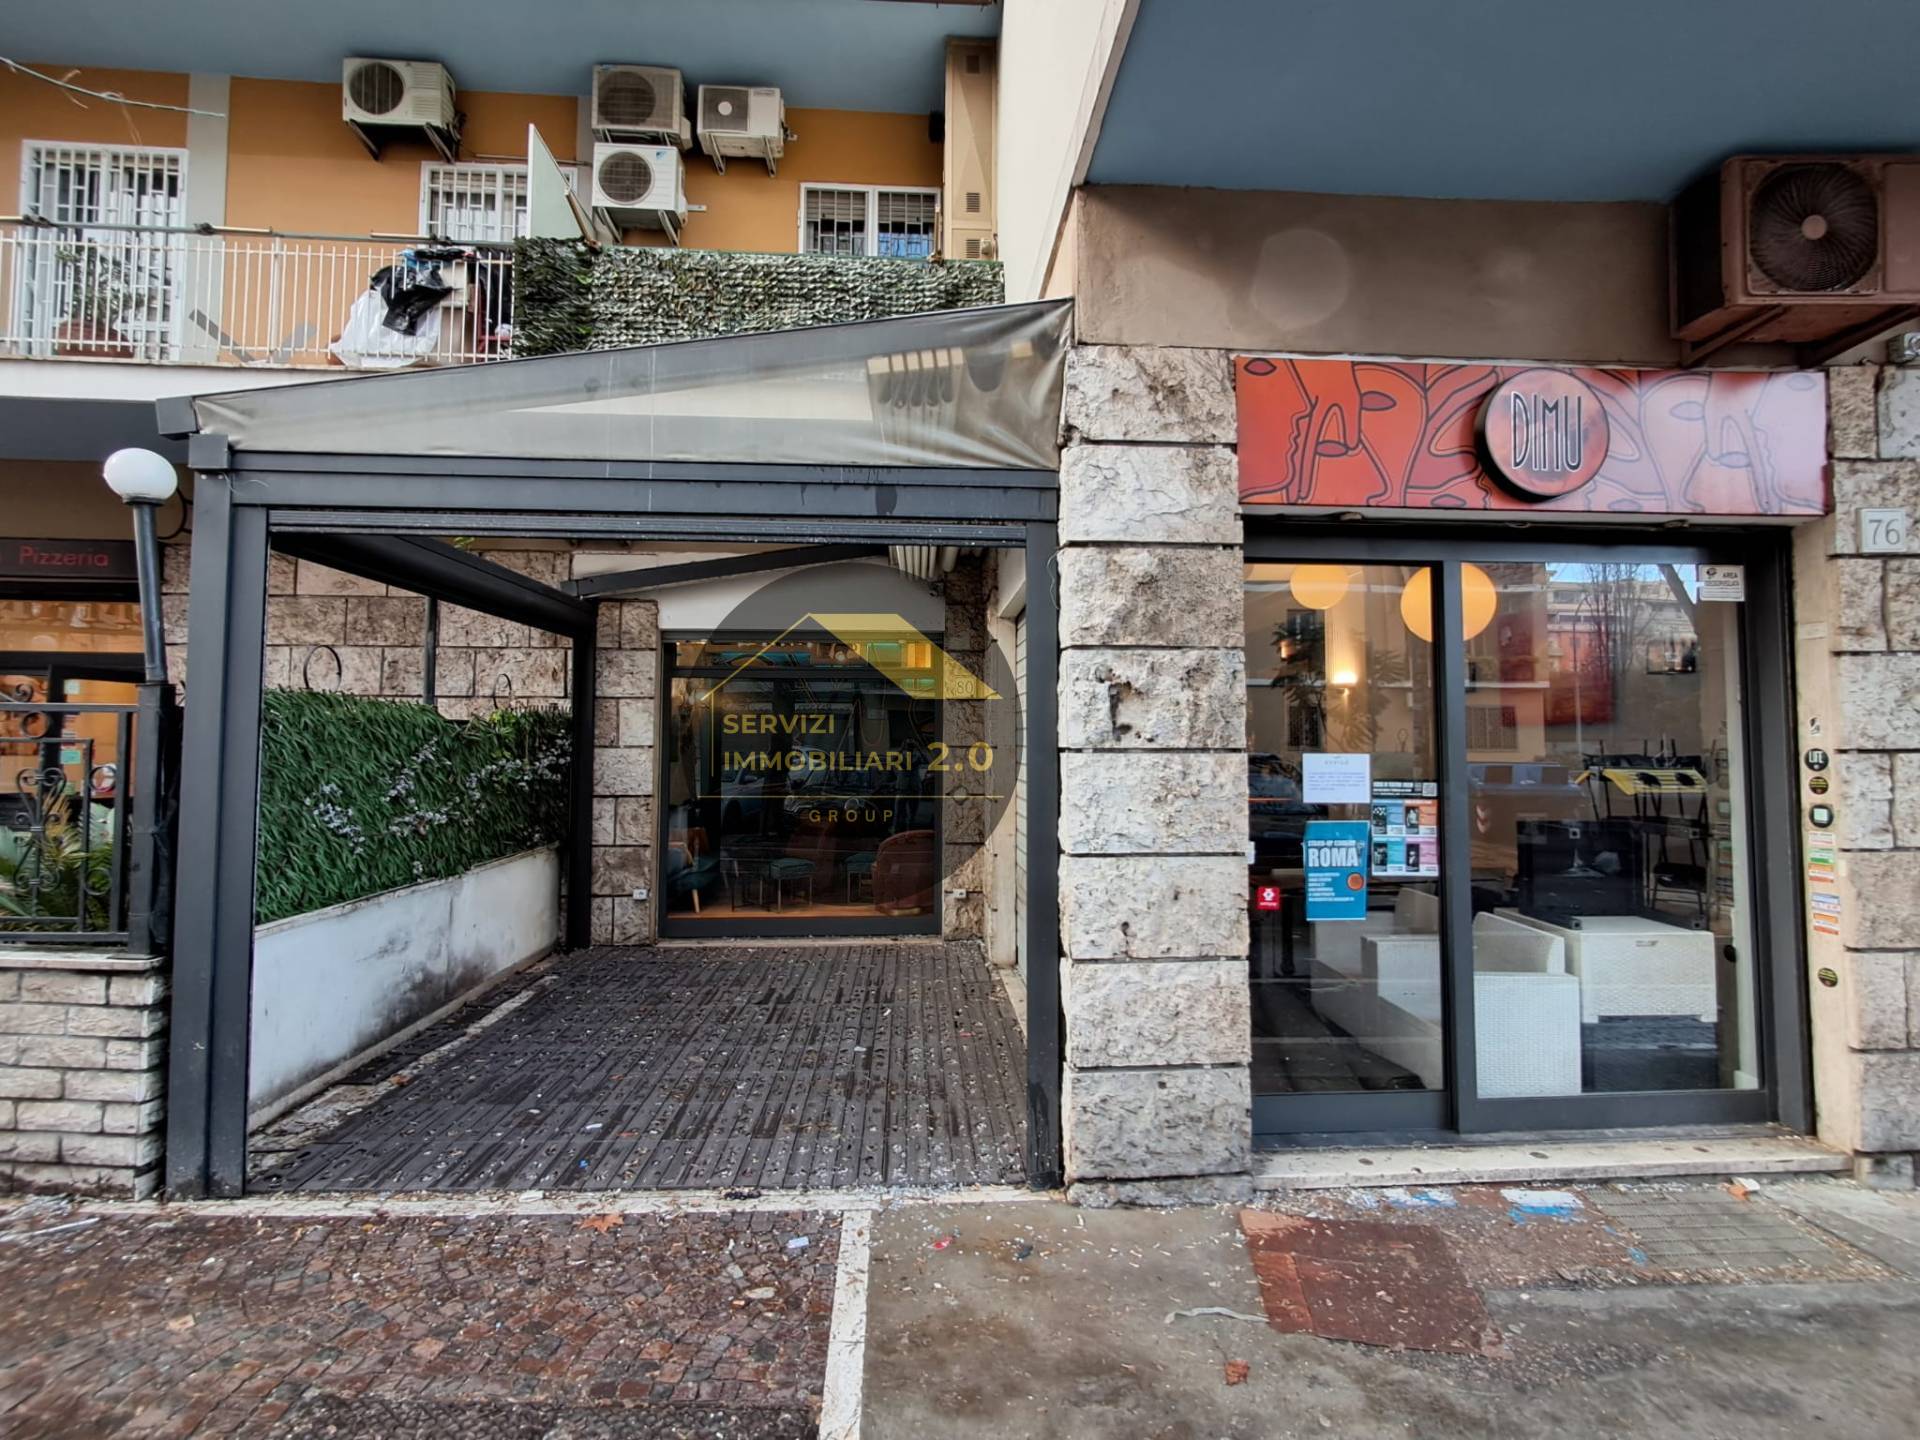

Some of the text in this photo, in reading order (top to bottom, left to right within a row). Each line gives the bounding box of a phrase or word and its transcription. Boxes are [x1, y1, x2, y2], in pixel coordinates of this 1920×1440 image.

[1511, 391, 1583, 472] DIMU
[1868, 518, 1901, 545] 76
[19, 545, 109, 567] Pizzeria
[1308, 847, 1359, 868] ROMA
